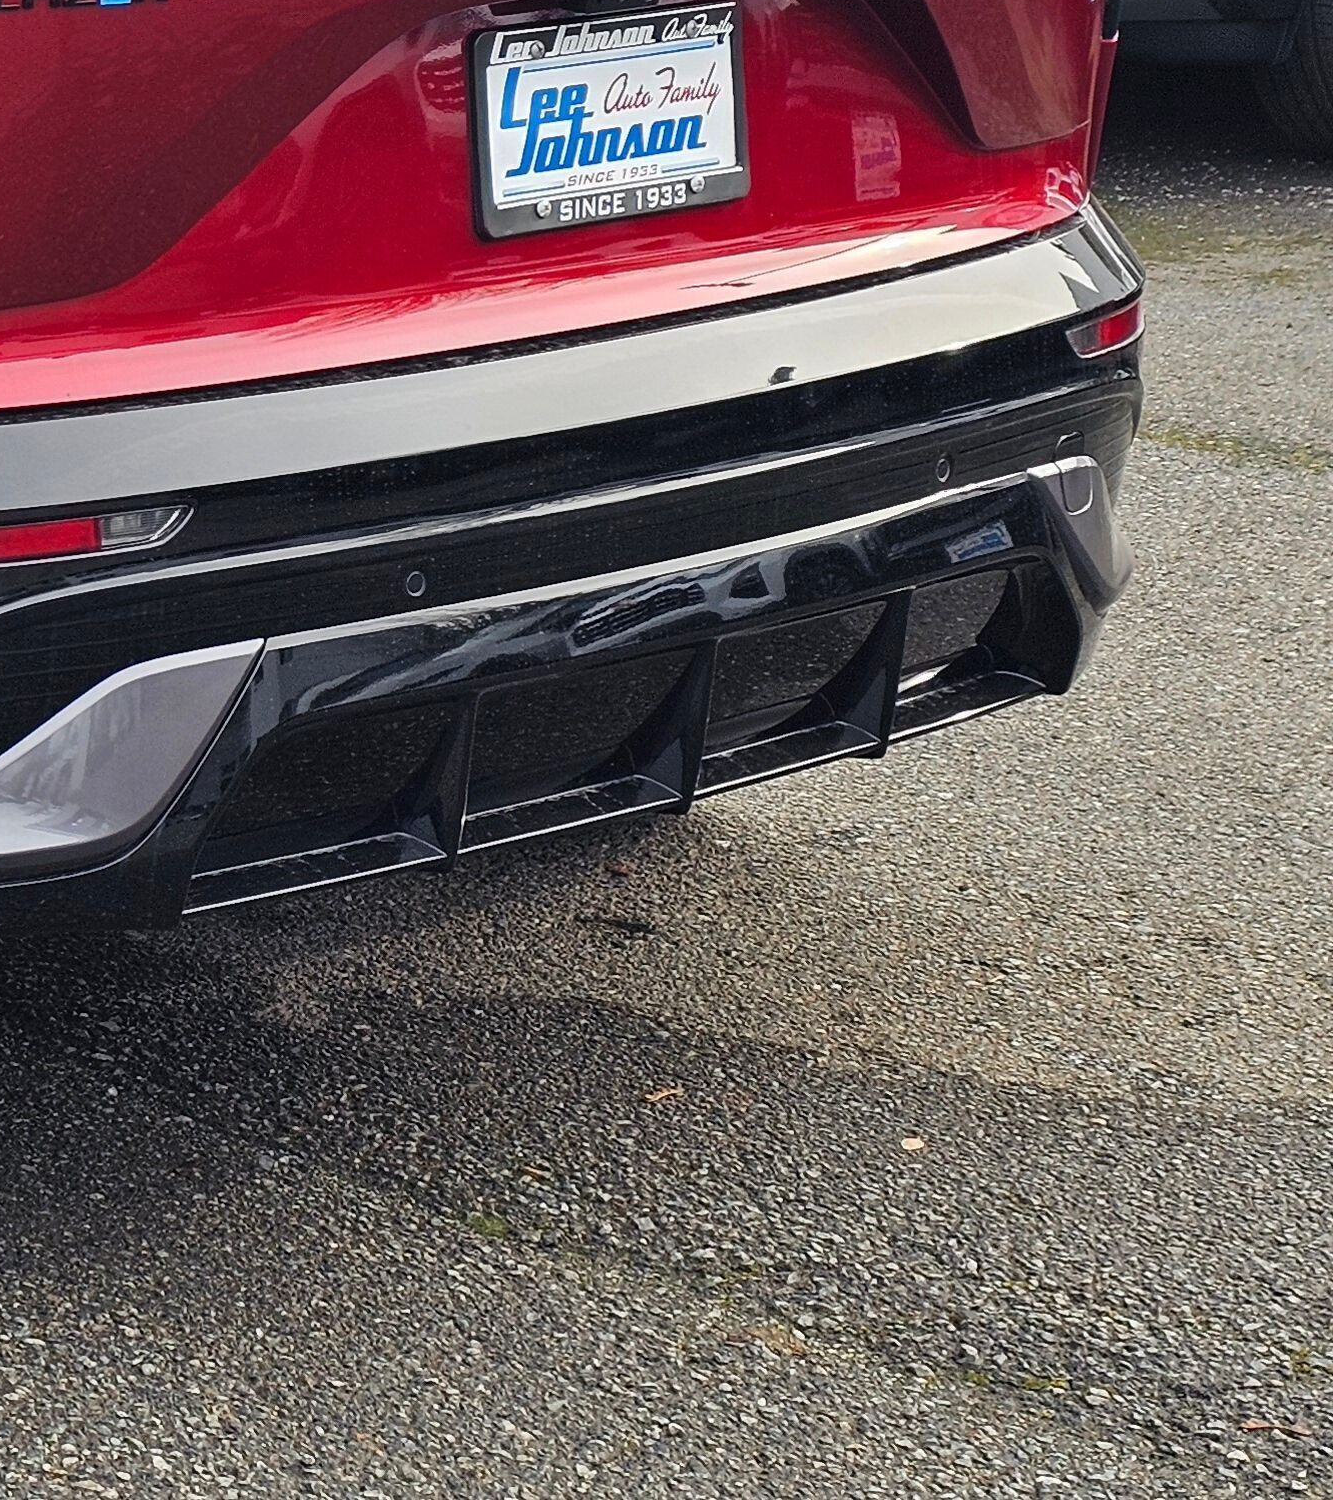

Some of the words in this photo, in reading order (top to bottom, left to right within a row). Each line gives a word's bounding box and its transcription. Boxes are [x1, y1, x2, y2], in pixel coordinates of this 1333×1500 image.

[545, 22, 657, 57] Johnson
[661, 17, 695, 42] Aut
[694, 11, 734, 40] Family
[500, 67, 594, 129] Lee
[604, 73, 653, 114] Auto
[655, 61, 720, 115] Family
[505, 113, 707, 177] Johnson
[567, 169, 616, 187] SINCE
[621, 164, 659, 180] 1933
[558, 193, 626, 222] SINCE
[634, 182, 687, 211] 1933
